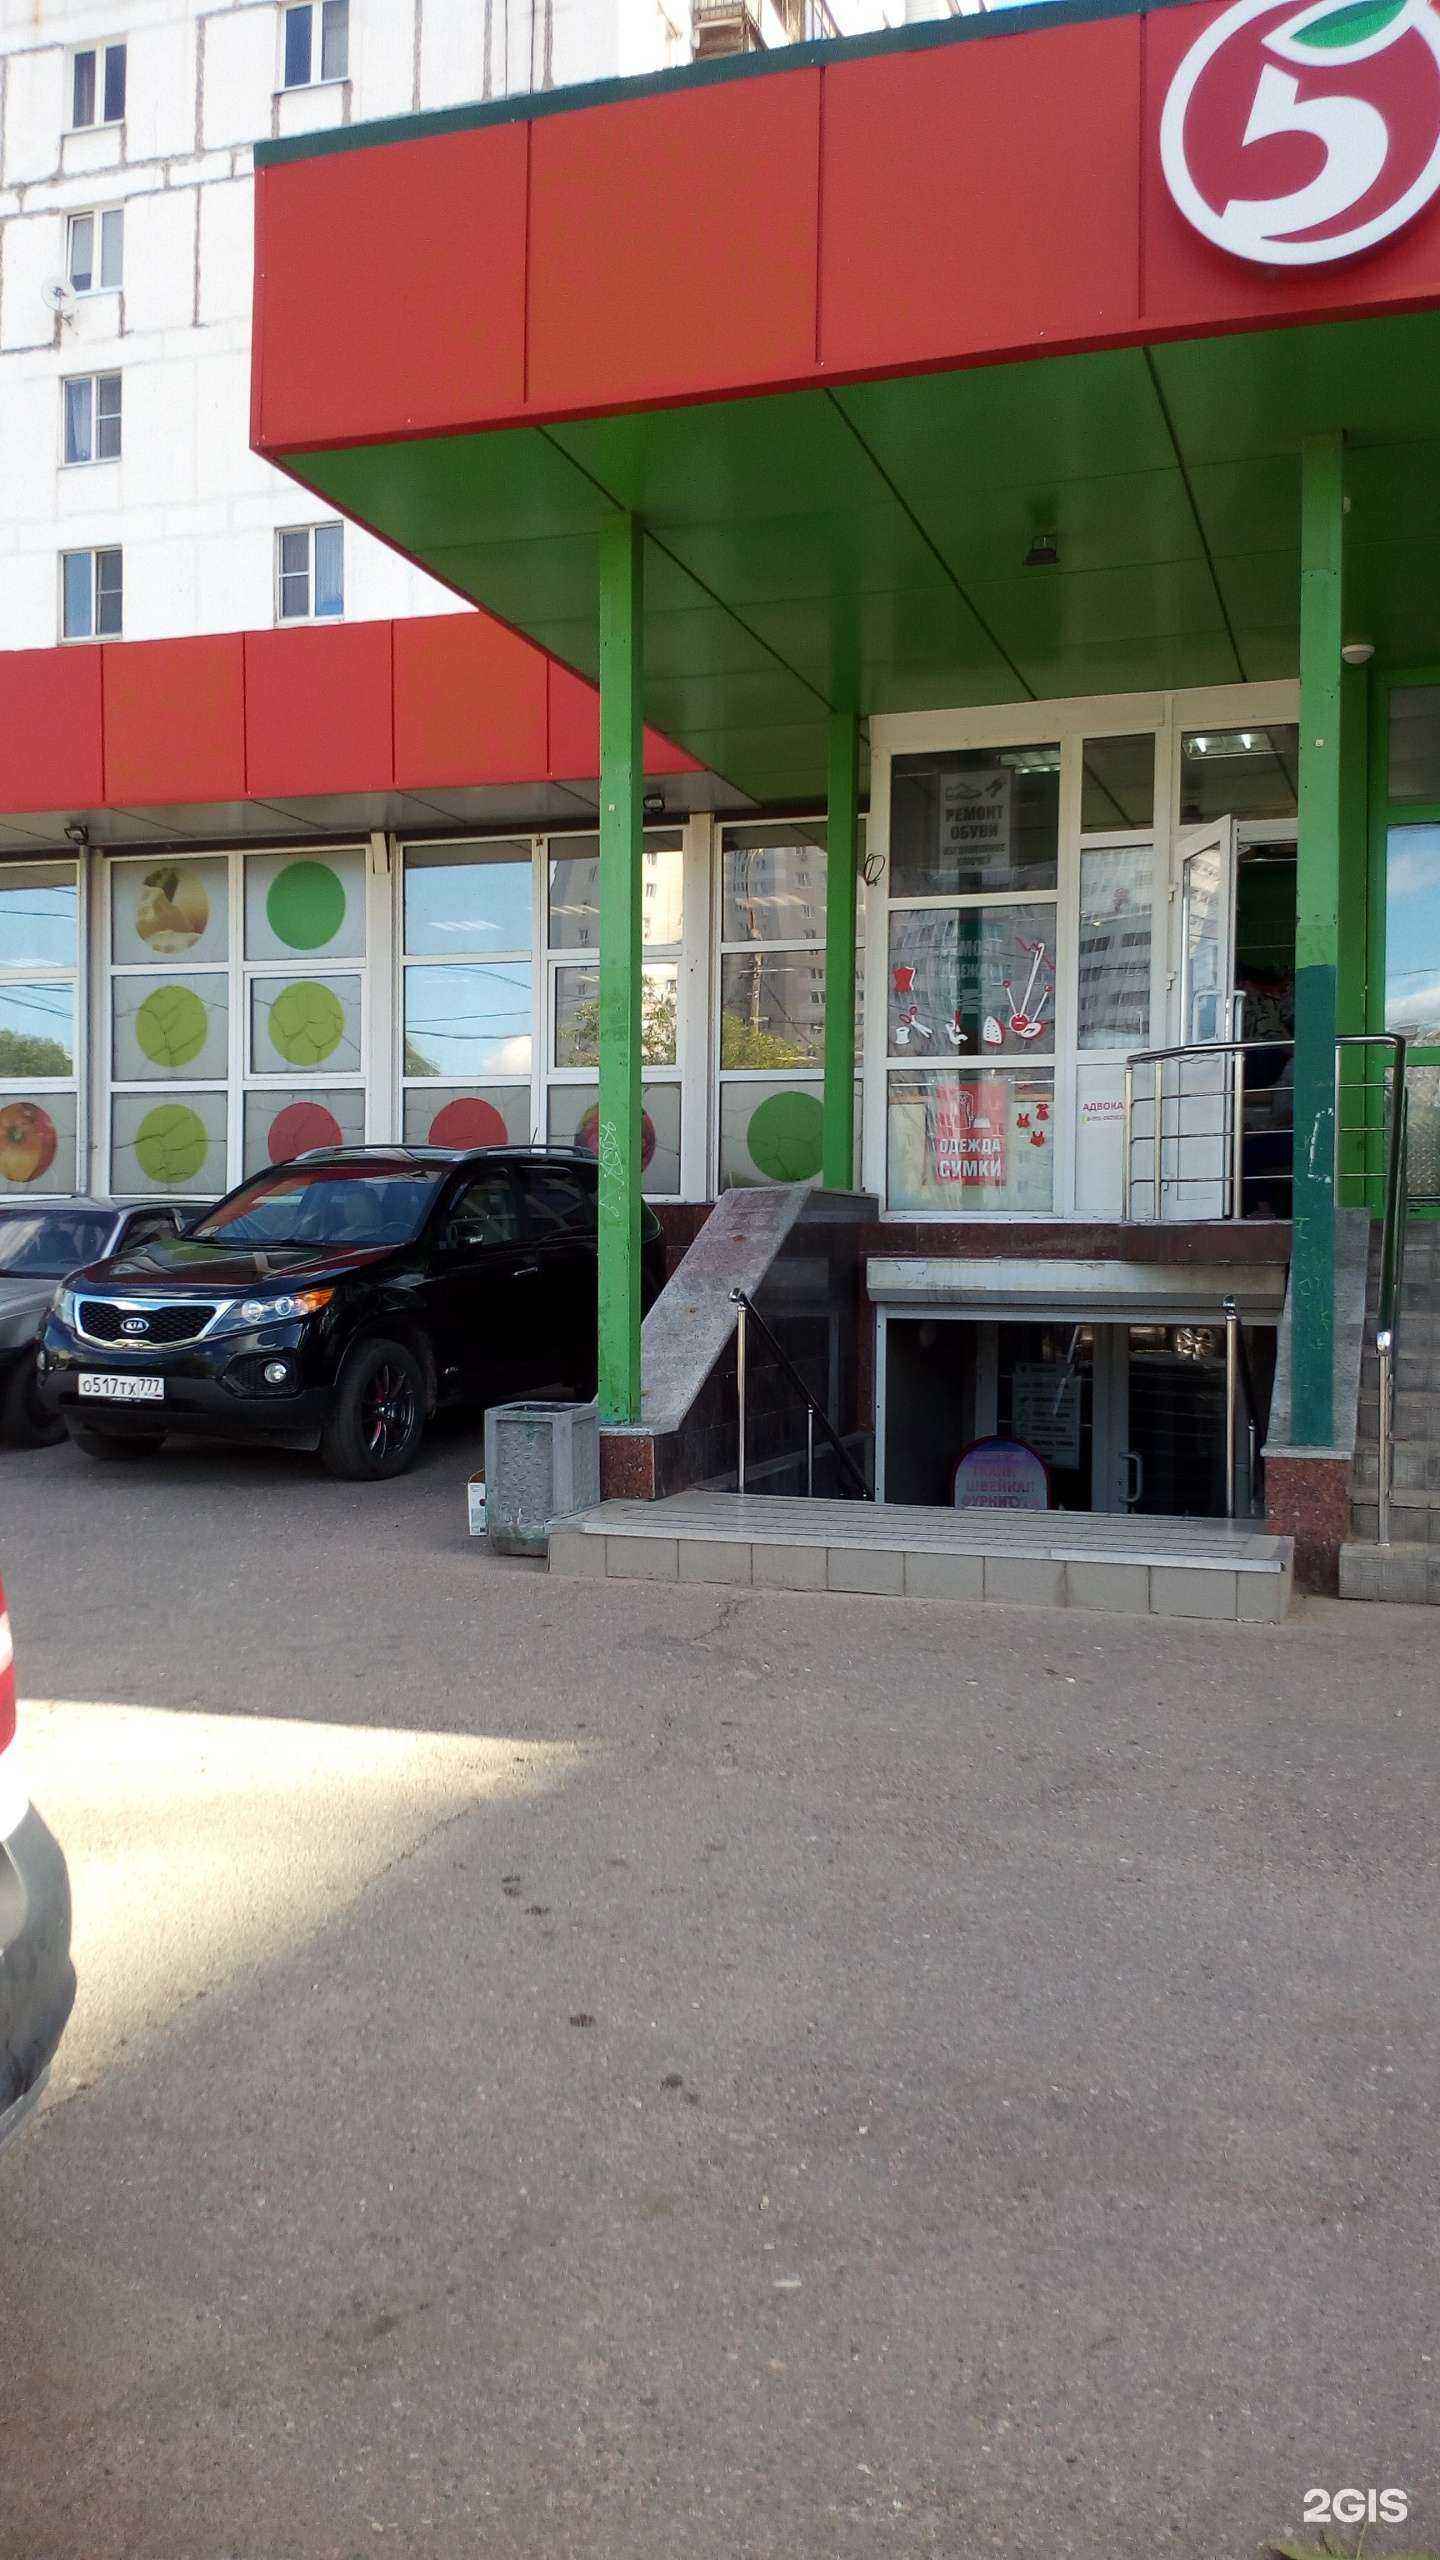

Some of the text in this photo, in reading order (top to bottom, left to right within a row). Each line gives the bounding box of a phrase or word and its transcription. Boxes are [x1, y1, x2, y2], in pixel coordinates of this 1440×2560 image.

[1217, 62, 1390, 241] 5
[945, 805, 1004, 822] РЕМОНТ
[950, 824, 998, 840] ОБУВИ
[1083, 1101, 1126, 1112] АДВОКА
[940, 1138, 1001, 1155] ОДЕЖДА
[940, 1159, 1001, 1178] СУМКИ
